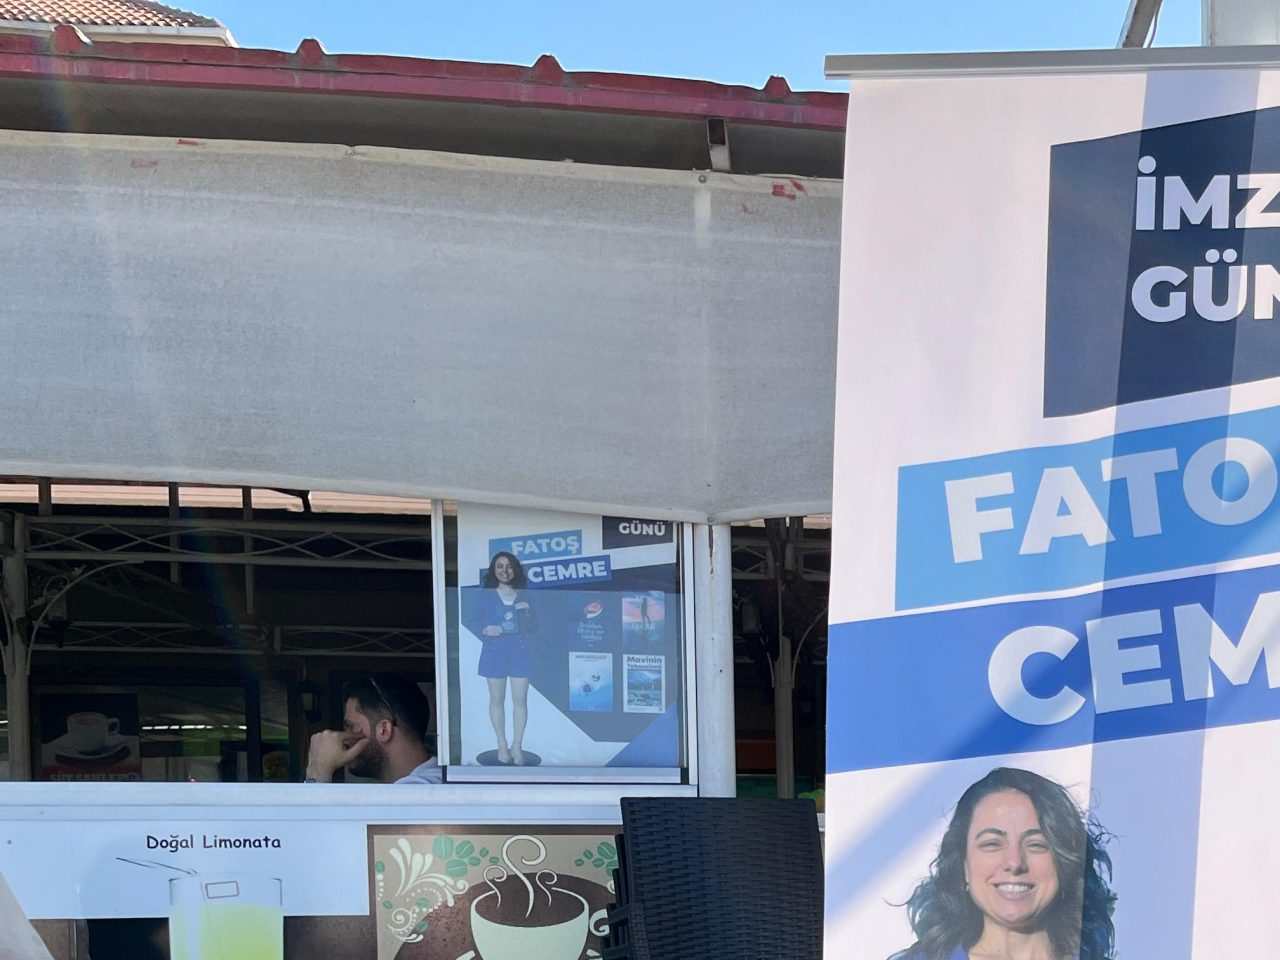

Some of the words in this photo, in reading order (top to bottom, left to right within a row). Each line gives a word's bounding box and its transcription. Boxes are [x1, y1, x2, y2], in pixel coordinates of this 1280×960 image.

[618, 521, 666, 537] GÜNÜ
[511, 535, 580, 556] FATOŞ
[527, 560, 608, 583] CEMRE
[146, 834, 195, 853] Doğal
[202, 834, 282, 849] Limonata
